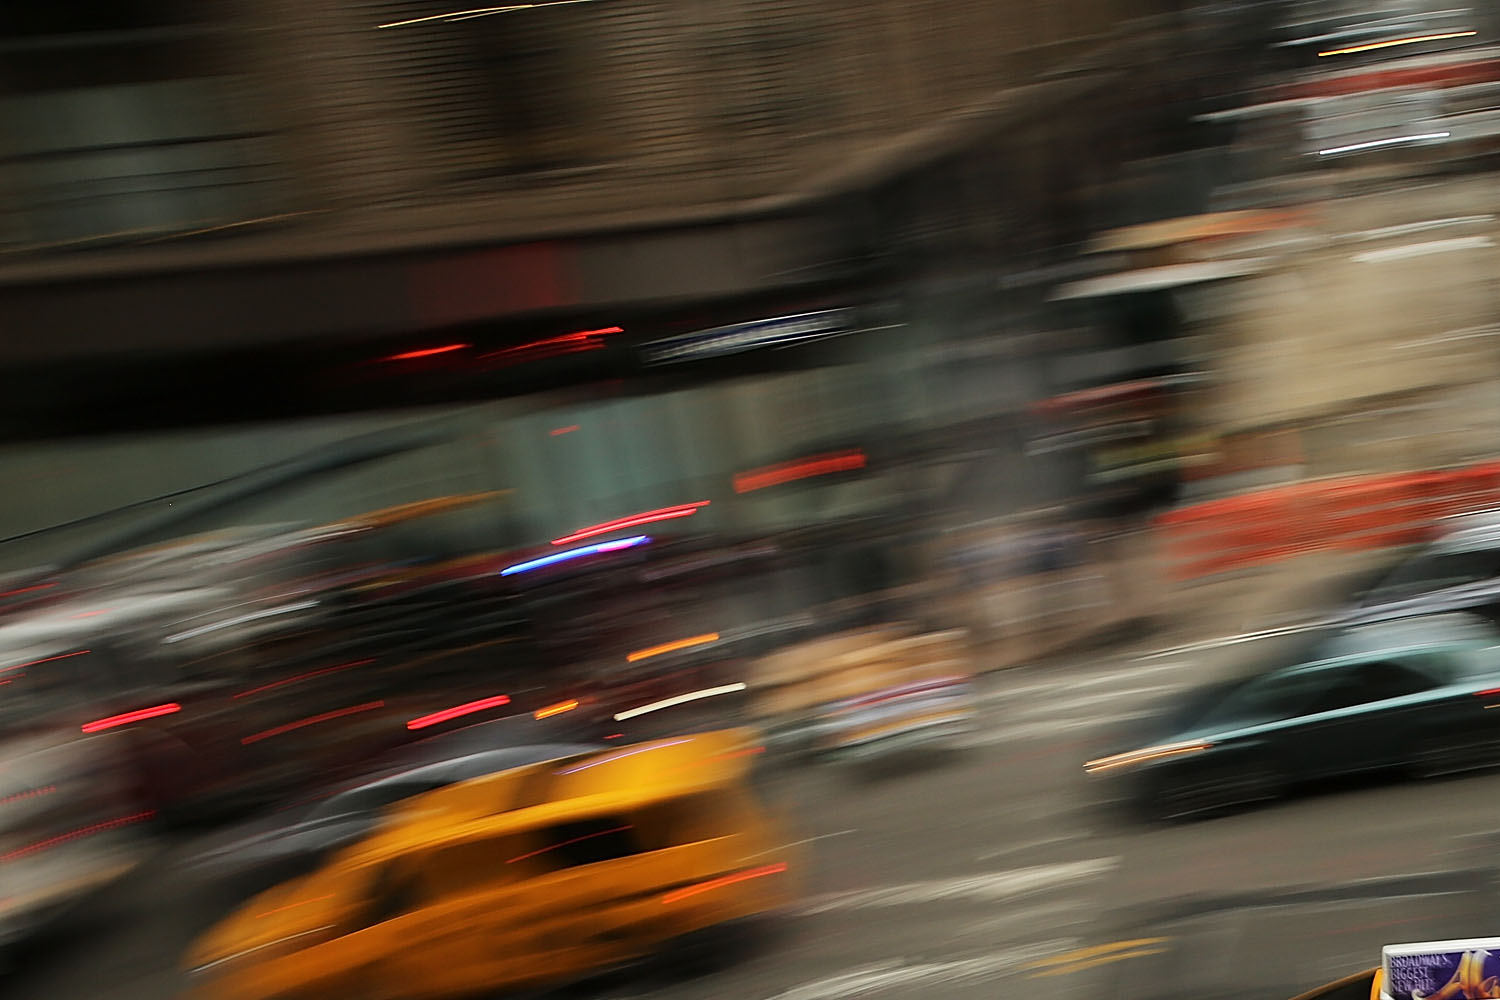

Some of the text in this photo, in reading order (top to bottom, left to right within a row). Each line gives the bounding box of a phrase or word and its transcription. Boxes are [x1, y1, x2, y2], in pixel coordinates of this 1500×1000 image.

[1391, 954, 1451, 968] BROADWAY'S
[1391, 966, 1429, 980] BIGGEST
[1392, 979, 1411, 992] NEW
